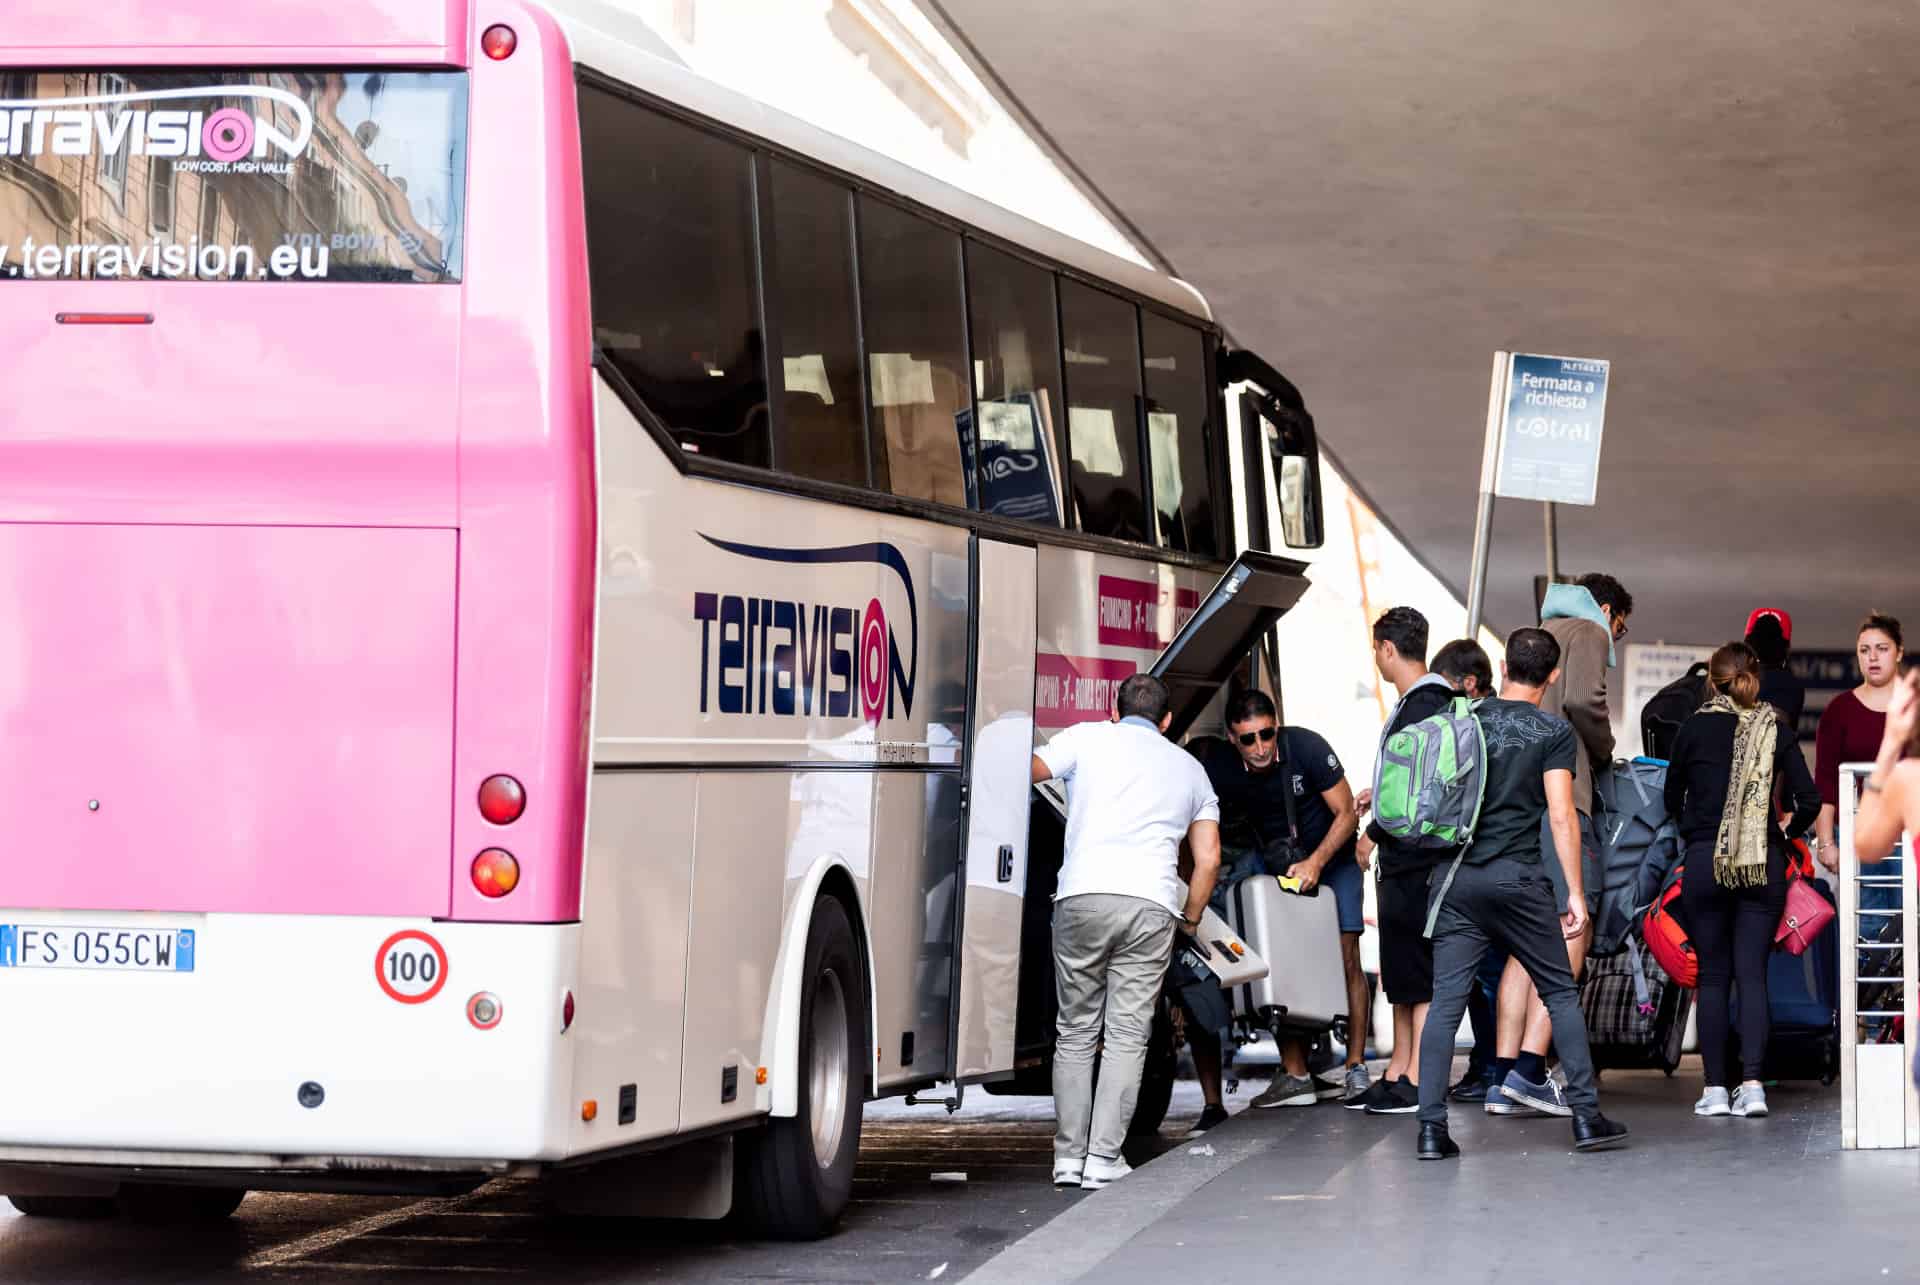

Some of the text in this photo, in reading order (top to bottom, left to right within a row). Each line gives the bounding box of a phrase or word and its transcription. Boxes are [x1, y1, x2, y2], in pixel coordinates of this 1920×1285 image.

[173, 161, 296, 175] LOW COST, HIGH VALUE
[0, 235, 329, 278] .terravision.eu
[1521, 372, 1595, 394] Fermata a
[1525, 389, 1587, 410] richiesta
[22, 931, 59, 963] FS
[73, 931, 171, 966] 055CW
[389, 951, 436, 982] 100
